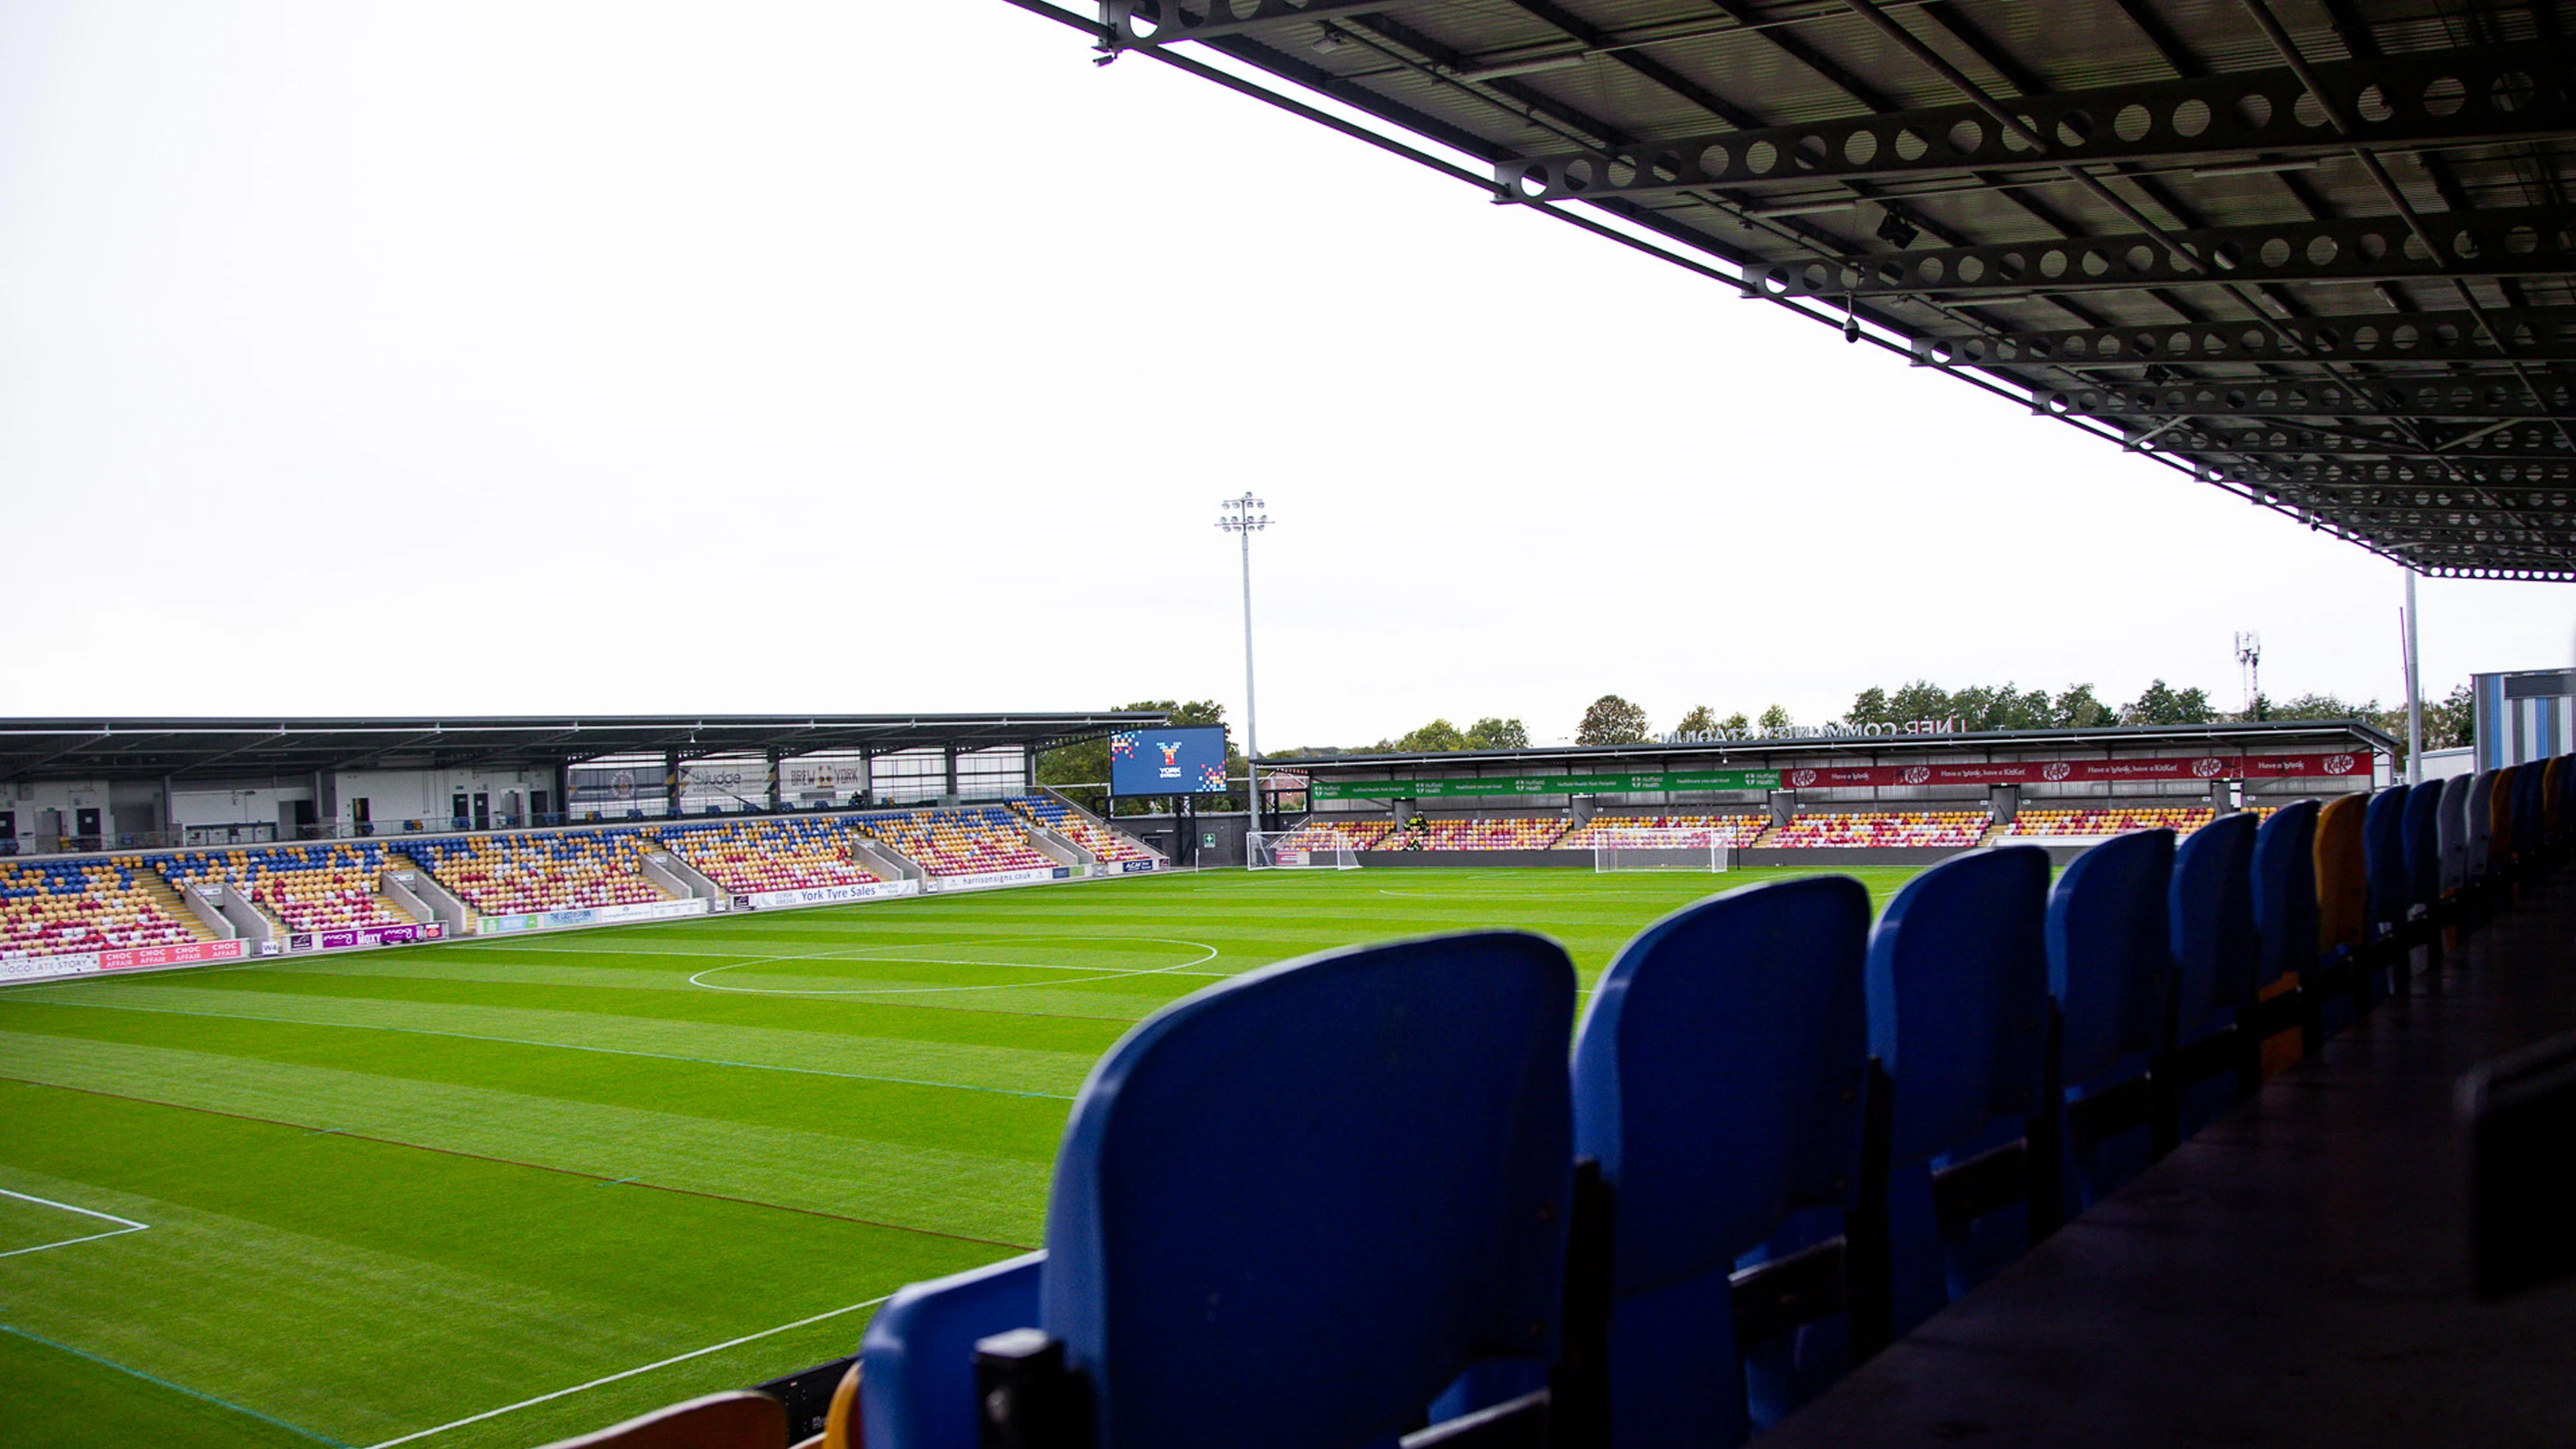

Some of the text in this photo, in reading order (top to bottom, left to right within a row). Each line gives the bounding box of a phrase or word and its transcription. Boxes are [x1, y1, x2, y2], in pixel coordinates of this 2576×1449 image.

[2044, 763, 2069, 780] KitKat
[2193, 758, 2221, 776] KitKat
[2324, 755, 2354, 774] KitKat
[791, 770, 815, 786] BREW
[835, 768, 859, 784] YORK
[1792, 770, 1816, 786] KitKat
[1905, 767, 1930, 783] KitKat
[801, 886, 876, 901] York Tyre Sales
[357, 933, 382, 945] MOXY
[140, 948, 166, 957] CHOC
